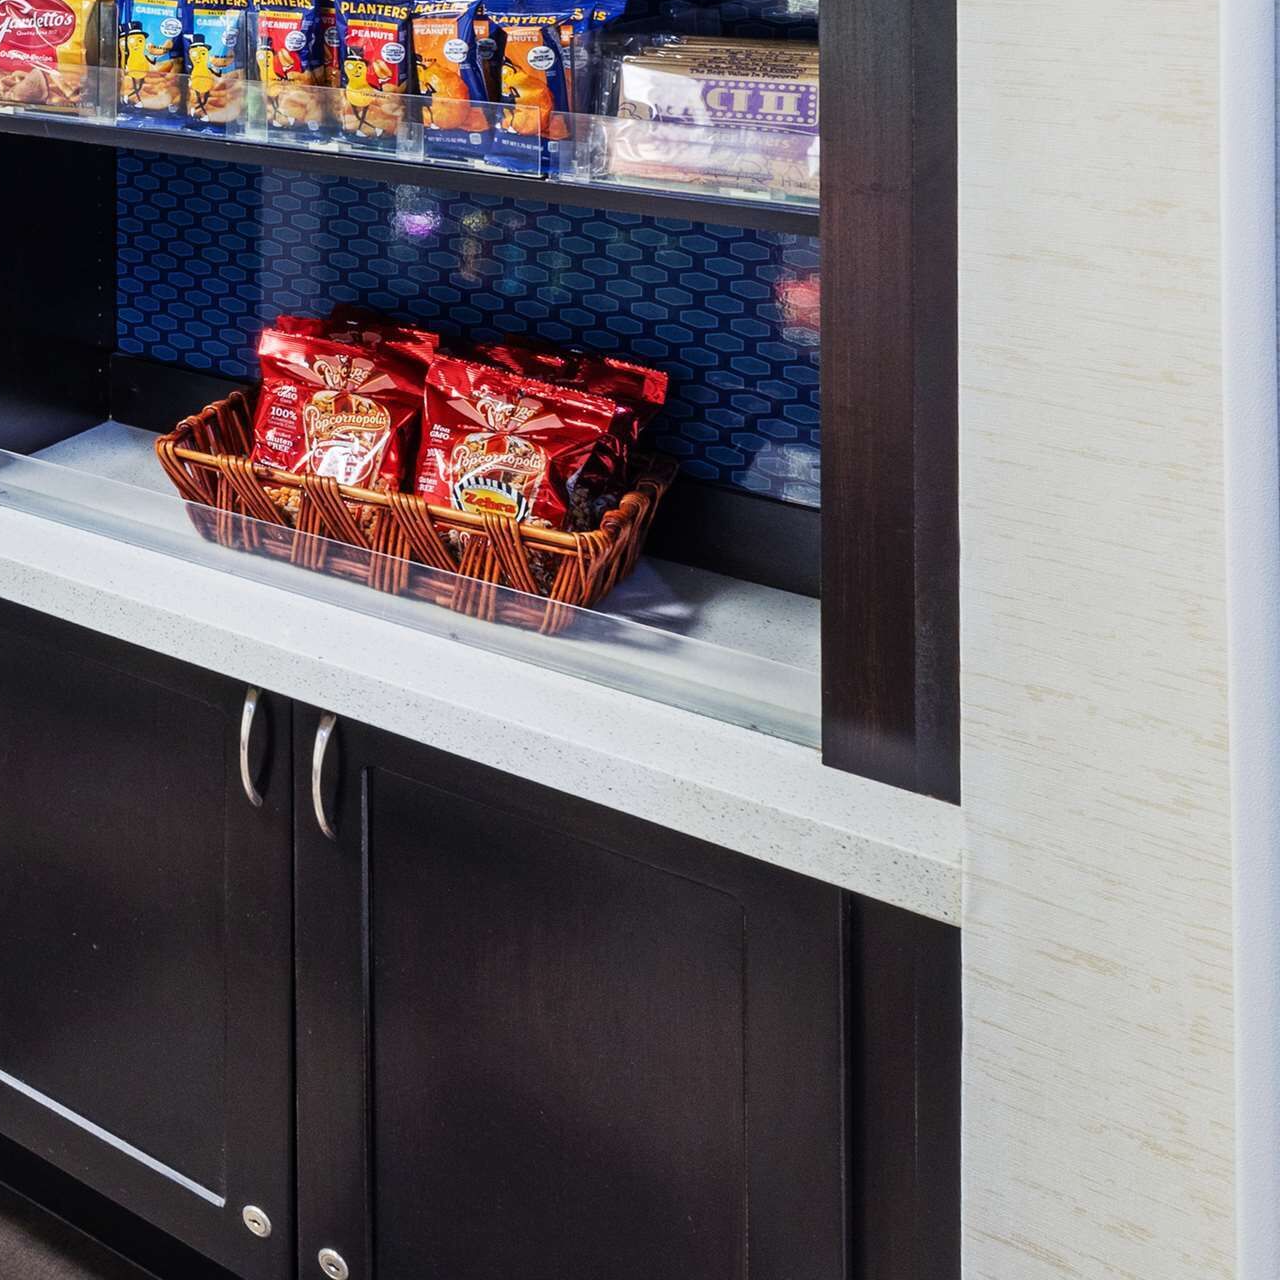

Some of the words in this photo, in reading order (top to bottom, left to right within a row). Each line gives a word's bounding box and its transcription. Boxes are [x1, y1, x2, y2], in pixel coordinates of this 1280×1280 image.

[340, 1, 408, 20] PLANTERS
[261, 20, 299, 29] PEANUTS
[488, 15, 557, 25] LANTERS
[351, 29, 394, 40] PEANUTS
[728, 69, 750, 77] Value
[762, 71, 800, 80] Popcorn!
[706, 87, 753, 113] CT
[759, 90, 802, 116] II
[271, 406, 298, 421] 100%
[304, 405, 387, 436] Popcornopolis
[432, 424, 451, 433] Non
[429, 431, 450, 440] GMO
[453, 445, 542, 472] Popcornopolis
[464, 491, 517, 513] Zebra
